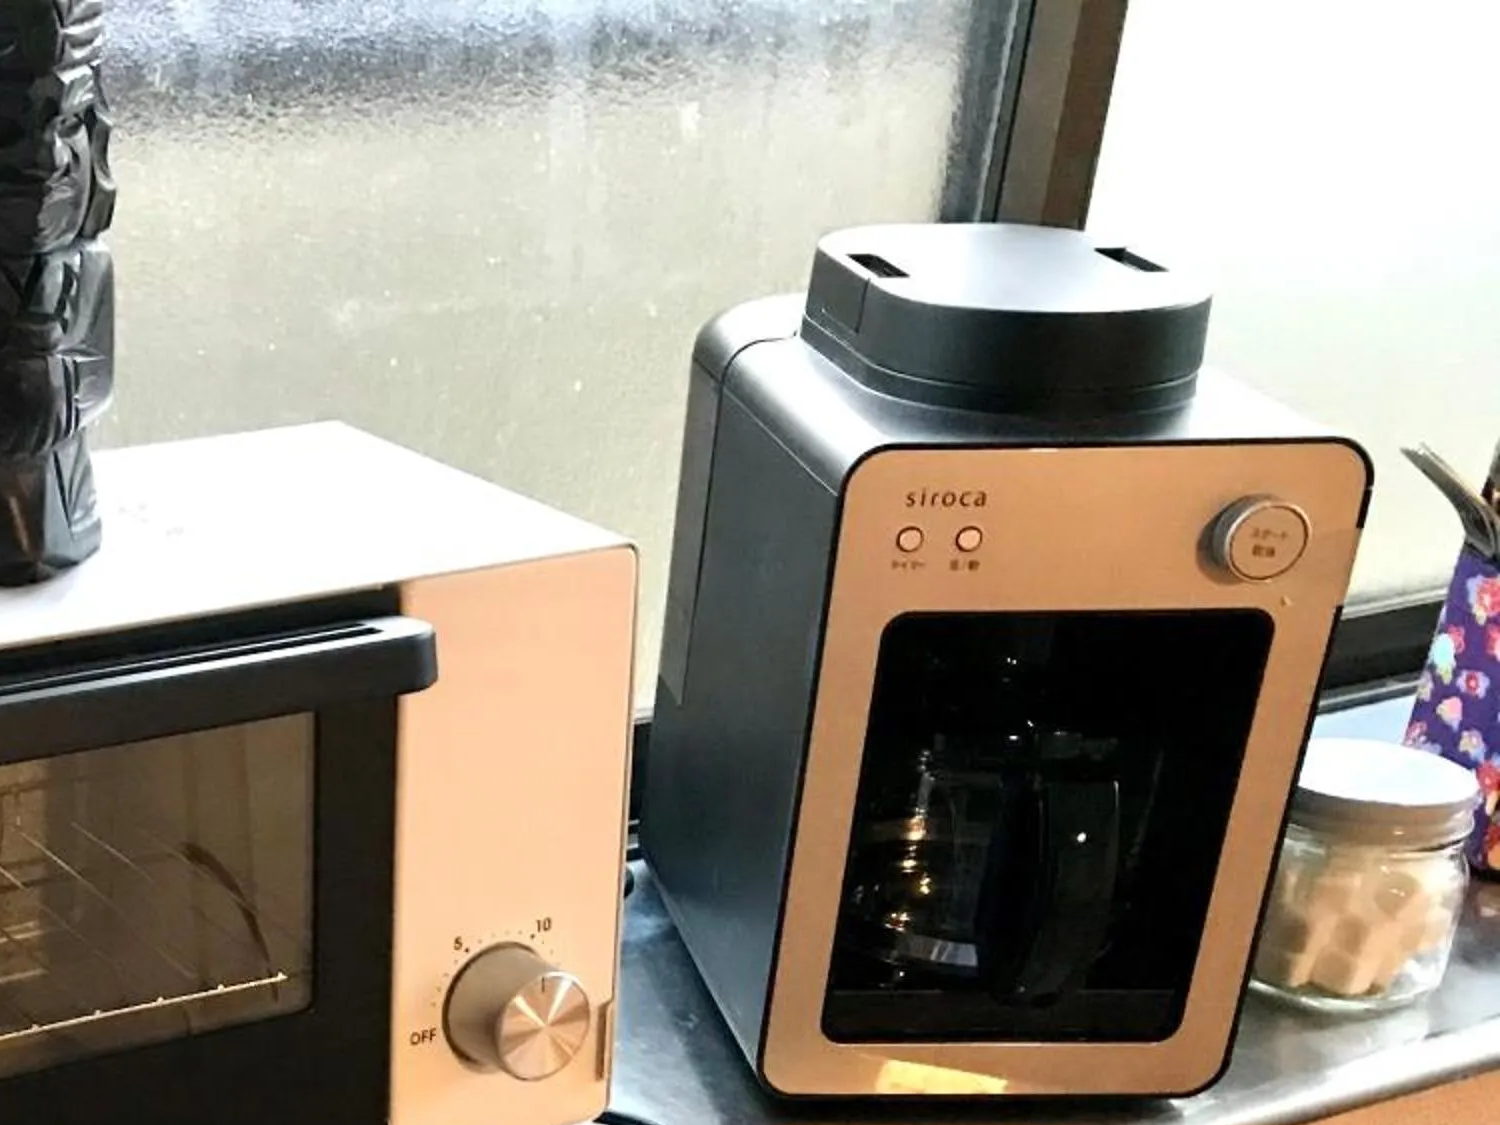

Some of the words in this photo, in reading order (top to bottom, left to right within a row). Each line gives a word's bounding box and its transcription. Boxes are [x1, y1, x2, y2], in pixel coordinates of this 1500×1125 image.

[905, 487, 987, 508] siroca
[535, 916, 552, 933] 10
[453, 935, 464, 951] 5
[409, 1027, 437, 1046] OFF
